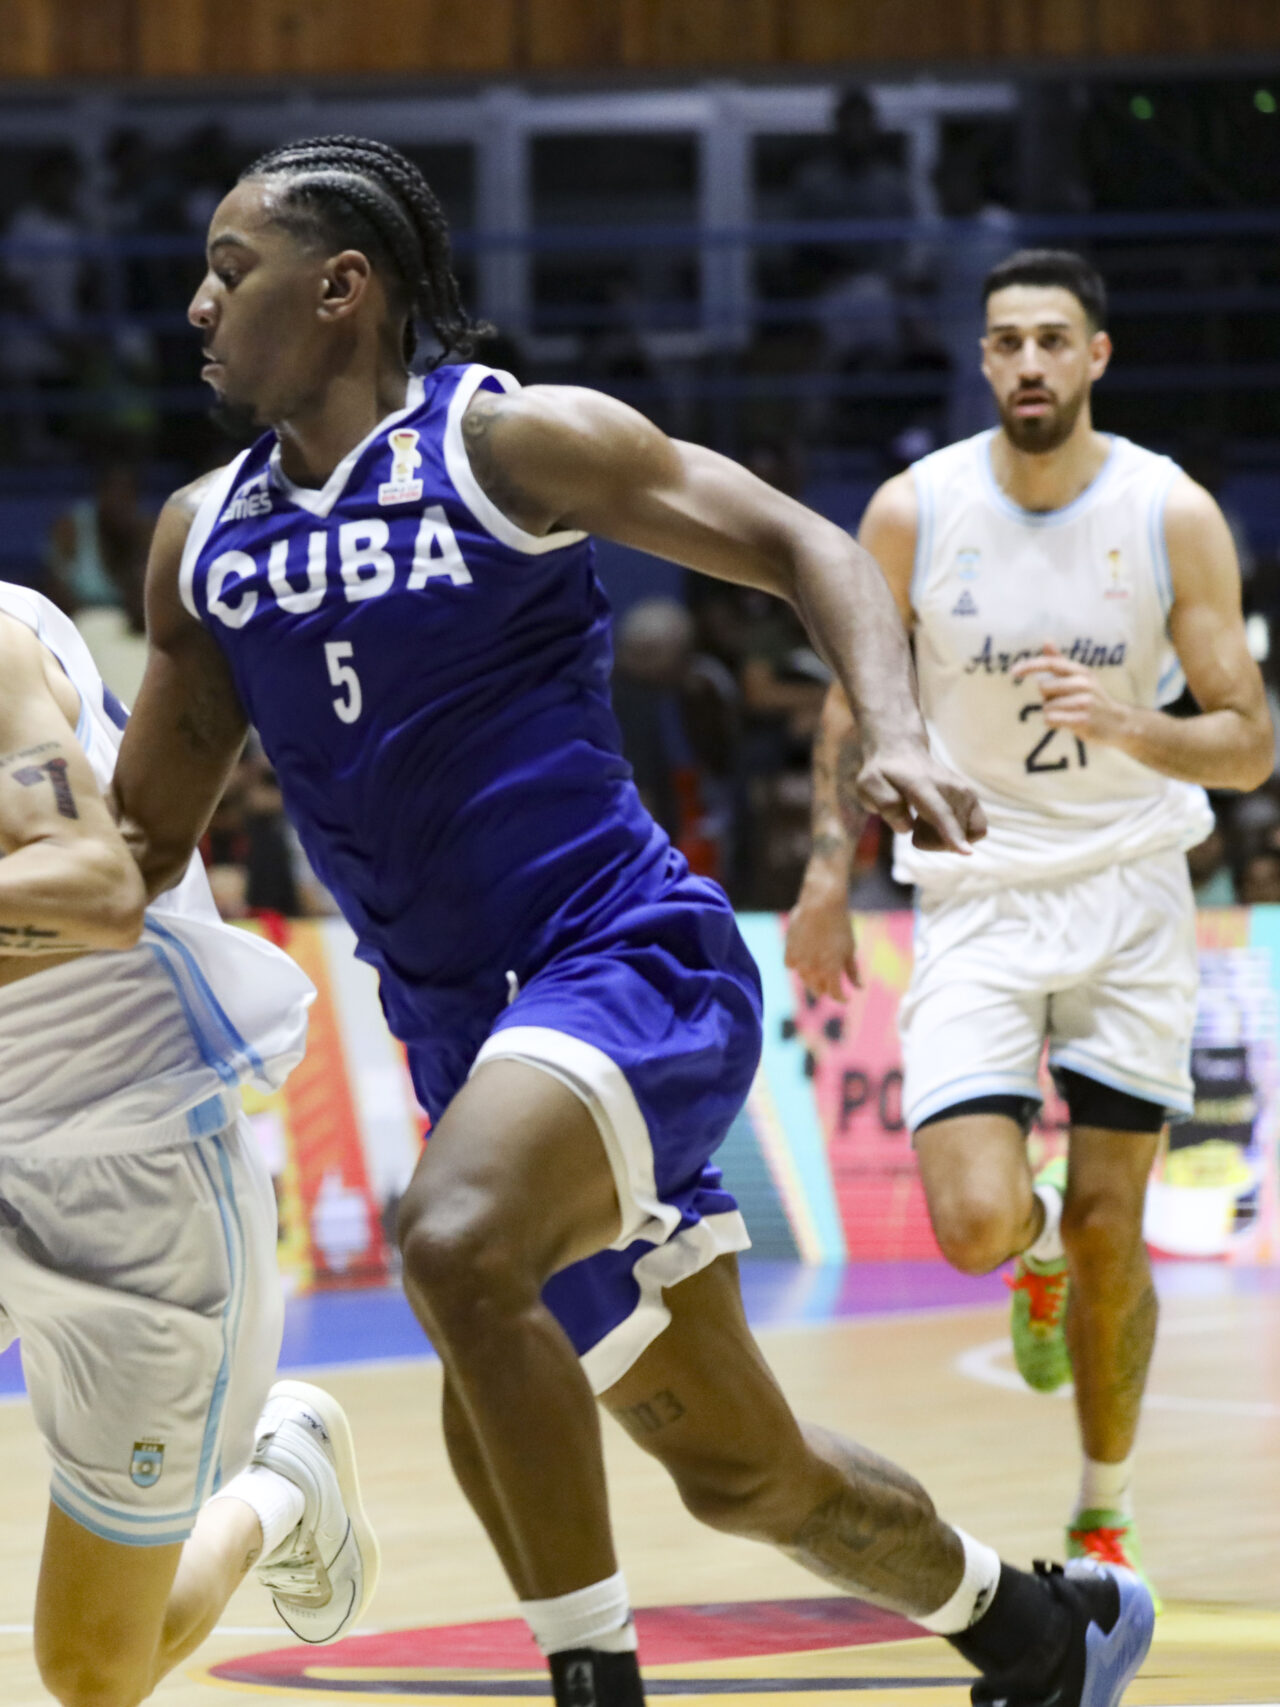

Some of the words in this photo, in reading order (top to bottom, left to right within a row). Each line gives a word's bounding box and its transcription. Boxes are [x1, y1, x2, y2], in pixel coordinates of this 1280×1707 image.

[206, 505, 473, 630] CUBA
[324, 641, 362, 724] 5
[964, 634, 1127, 686] Artina
